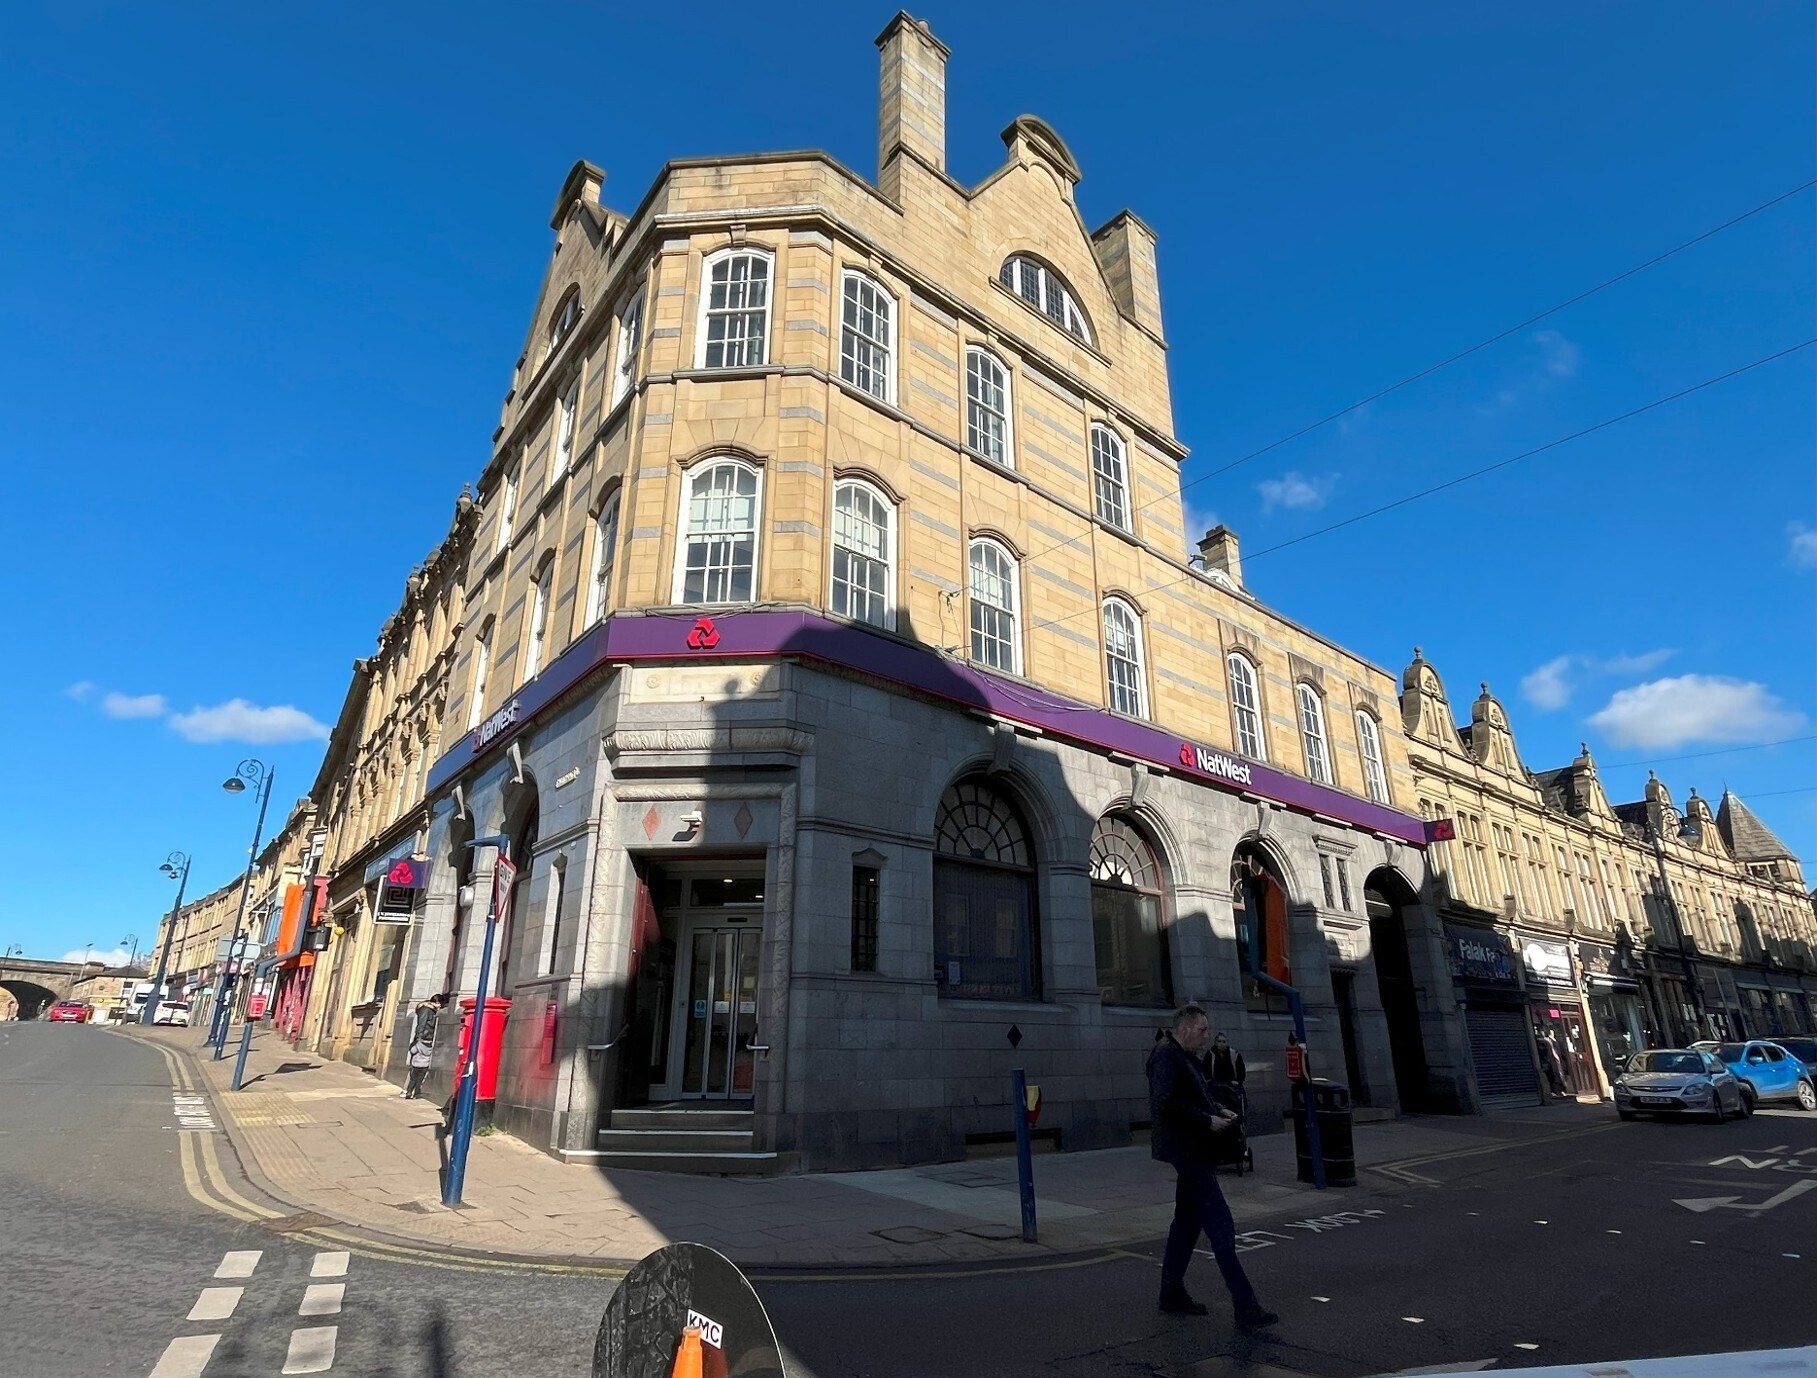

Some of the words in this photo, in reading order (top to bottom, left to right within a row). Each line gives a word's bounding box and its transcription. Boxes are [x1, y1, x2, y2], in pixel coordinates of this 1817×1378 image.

[479, 699, 519, 747] NatWest
[1196, 747, 1252, 785] NatWest
[1459, 939, 1486, 962] Falak
[689, 1313, 720, 1343] KMC
